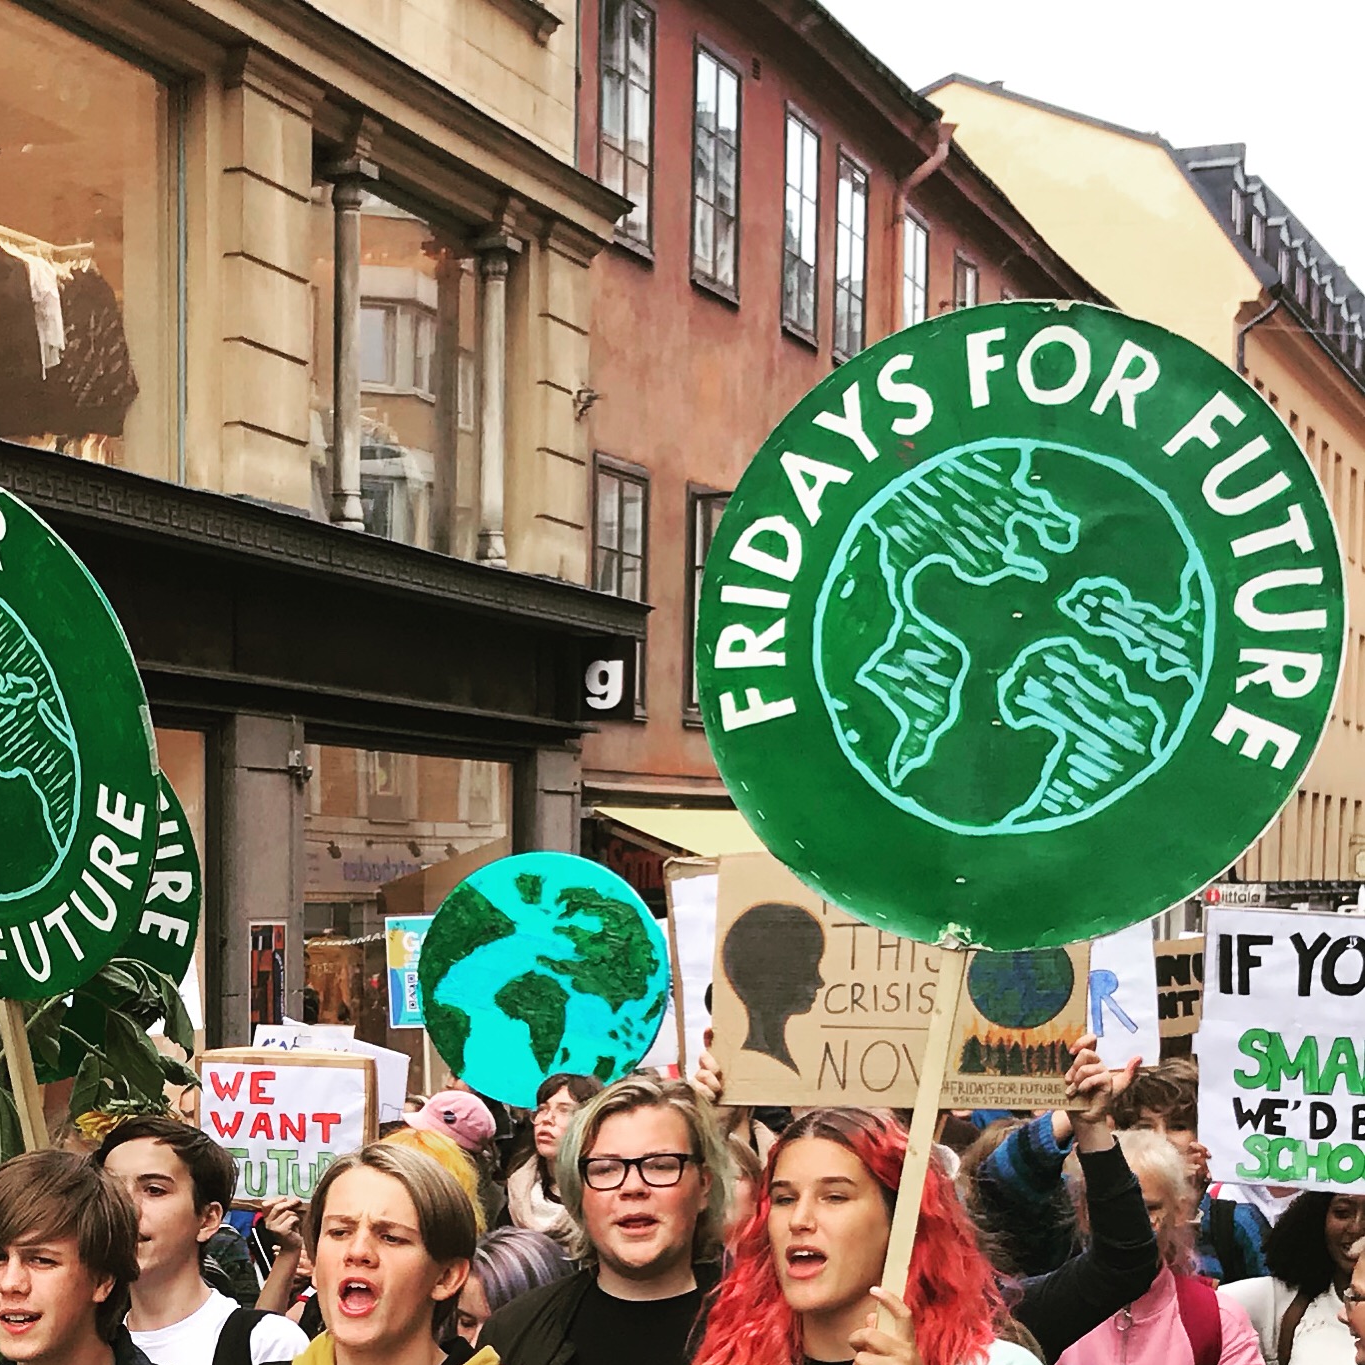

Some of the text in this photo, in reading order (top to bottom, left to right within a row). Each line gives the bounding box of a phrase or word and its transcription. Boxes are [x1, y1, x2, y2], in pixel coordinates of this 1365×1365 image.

[715, 324, 1326, 772] FRIDAYS FOR FUTURE
[585, 659, 624, 710] g
[1218, 933, 1274, 996] IF
[824, 982, 937, 1014] CRISIS
[209, 1070, 277, 1105] WE
[1234, 1028, 1365, 1096] SMA
[997, 1081, 1017, 1096] FOR
[1020, 1082, 1062, 1096] FUTURE
[209, 1111, 342, 1143] WANT
[1236, 1133, 1365, 1185] SCHO
